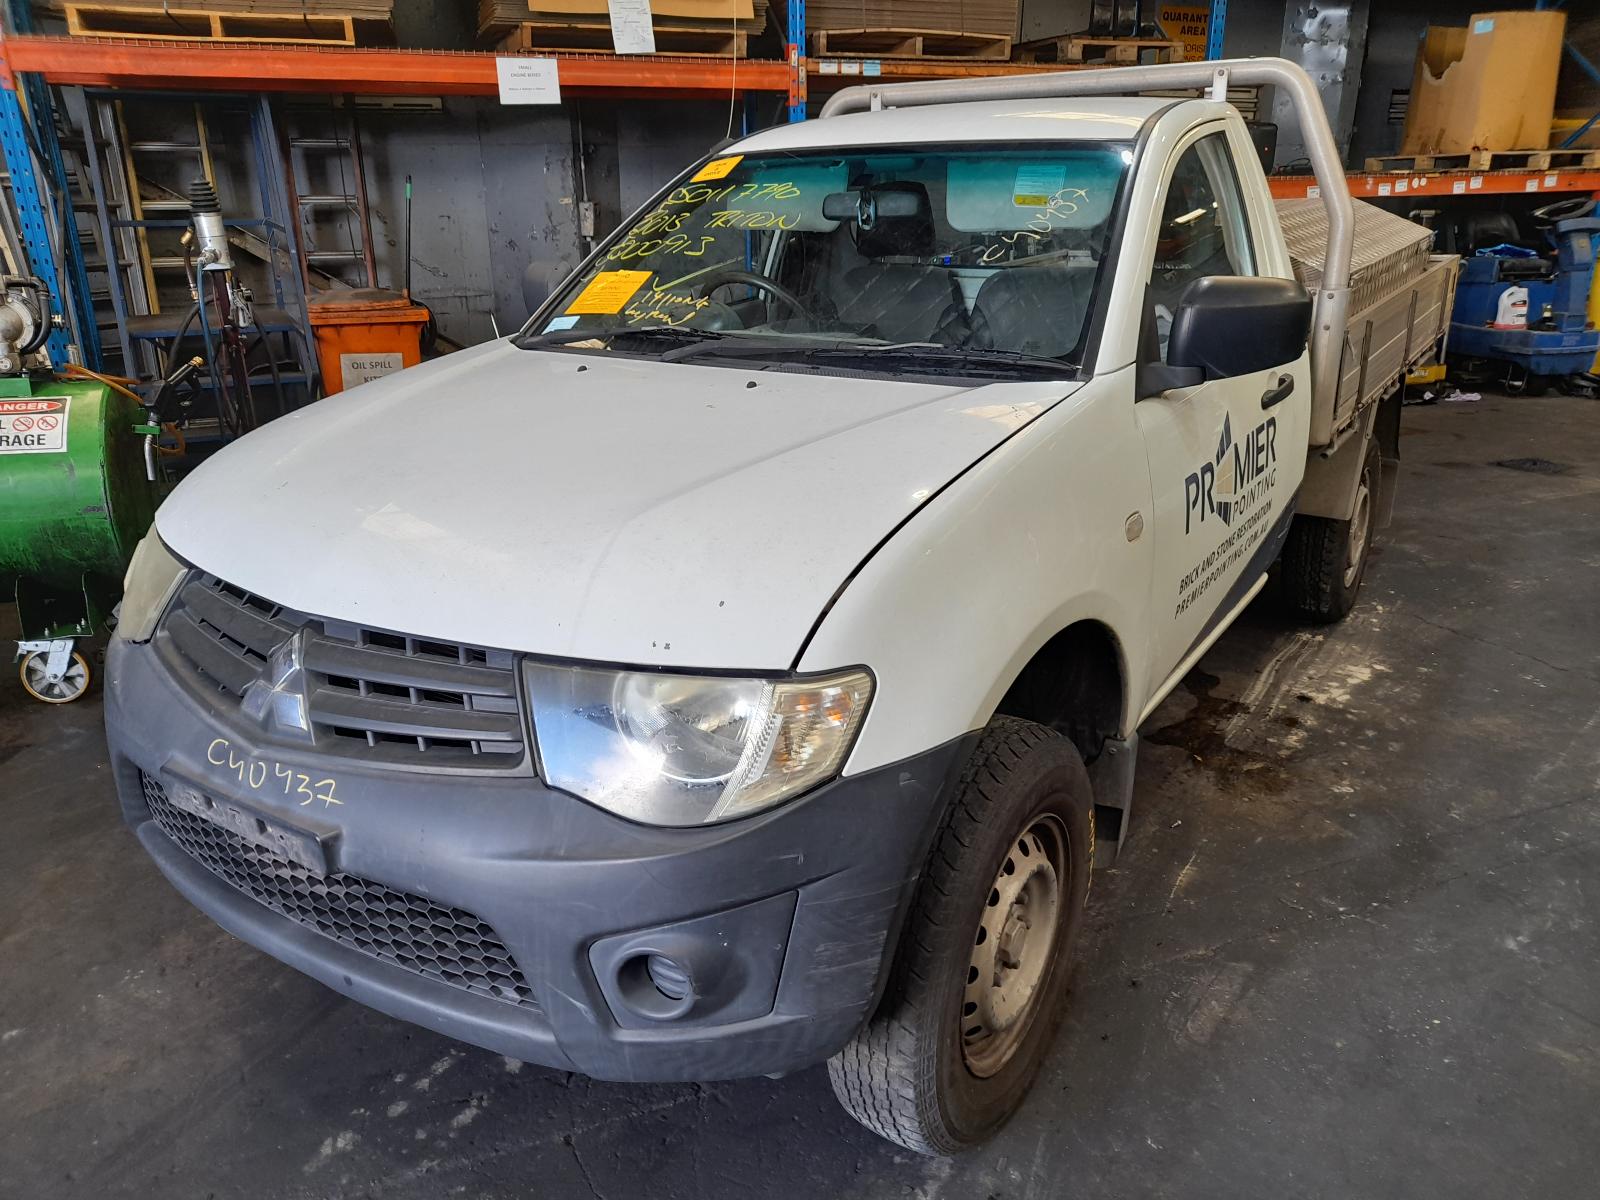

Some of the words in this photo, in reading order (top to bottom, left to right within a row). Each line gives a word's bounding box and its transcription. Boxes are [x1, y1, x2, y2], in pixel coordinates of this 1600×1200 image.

[1180, 25, 1206, 36] AREA
[704, 210, 801, 230] TRITON
[352, 361, 367, 369] OIL
[369, 361, 393, 369] SPILL
[1232, 468, 1277, 522] POINTING
[1179, 564, 1201, 596] BRICK
[1200, 551, 1216, 576] AND
[1216, 531, 1237, 560] STONE
[1236, 499, 1273, 540] RESTORATION
[207, 738, 345, 809] C40437
